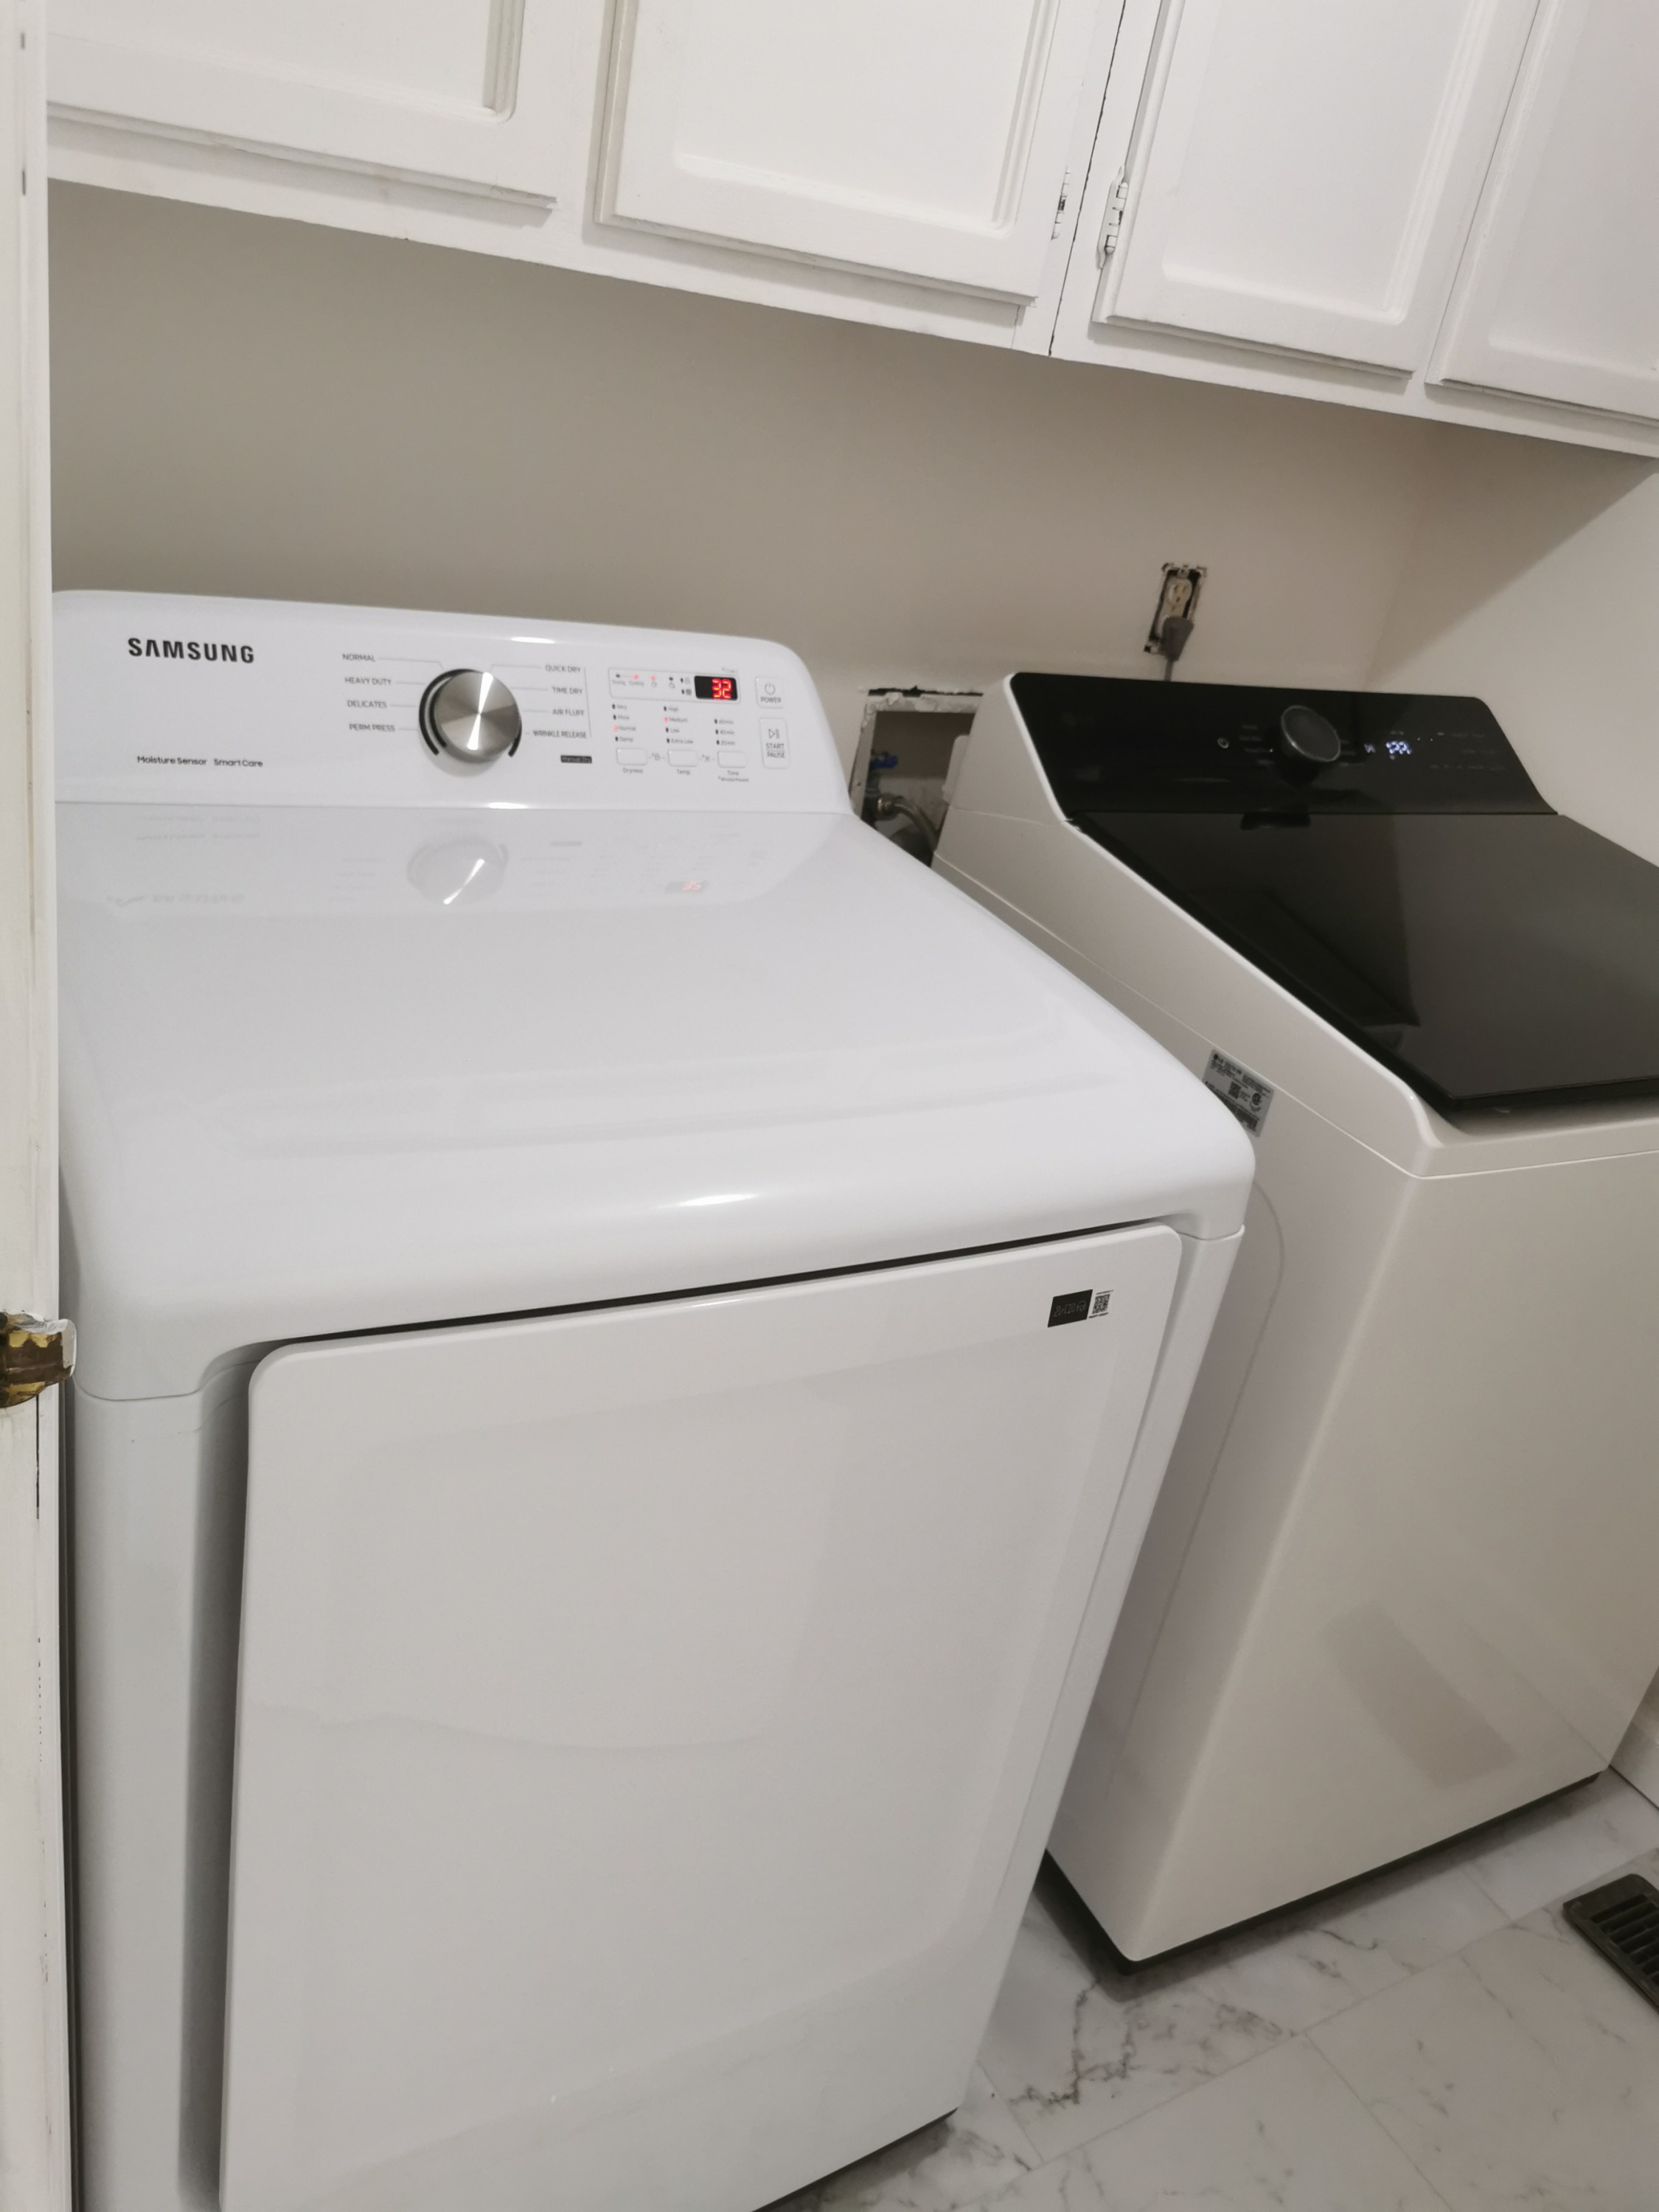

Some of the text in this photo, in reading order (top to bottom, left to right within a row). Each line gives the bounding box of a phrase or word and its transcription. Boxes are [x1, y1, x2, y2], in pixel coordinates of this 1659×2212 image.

[128, 637, 255, 664] SAMSUNG
[342, 653, 376, 662] NORMAL
[712, 678, 732, 699] 32
[347, 700, 387, 709] DELICATES
[372, 724, 396, 732] PRESS
[532, 730, 587, 739] WRINKLE RELEASE
[137, 756, 175, 765] Moisture
[177, 757, 207, 765] Sensor
[214, 758, 241, 766] Smart
